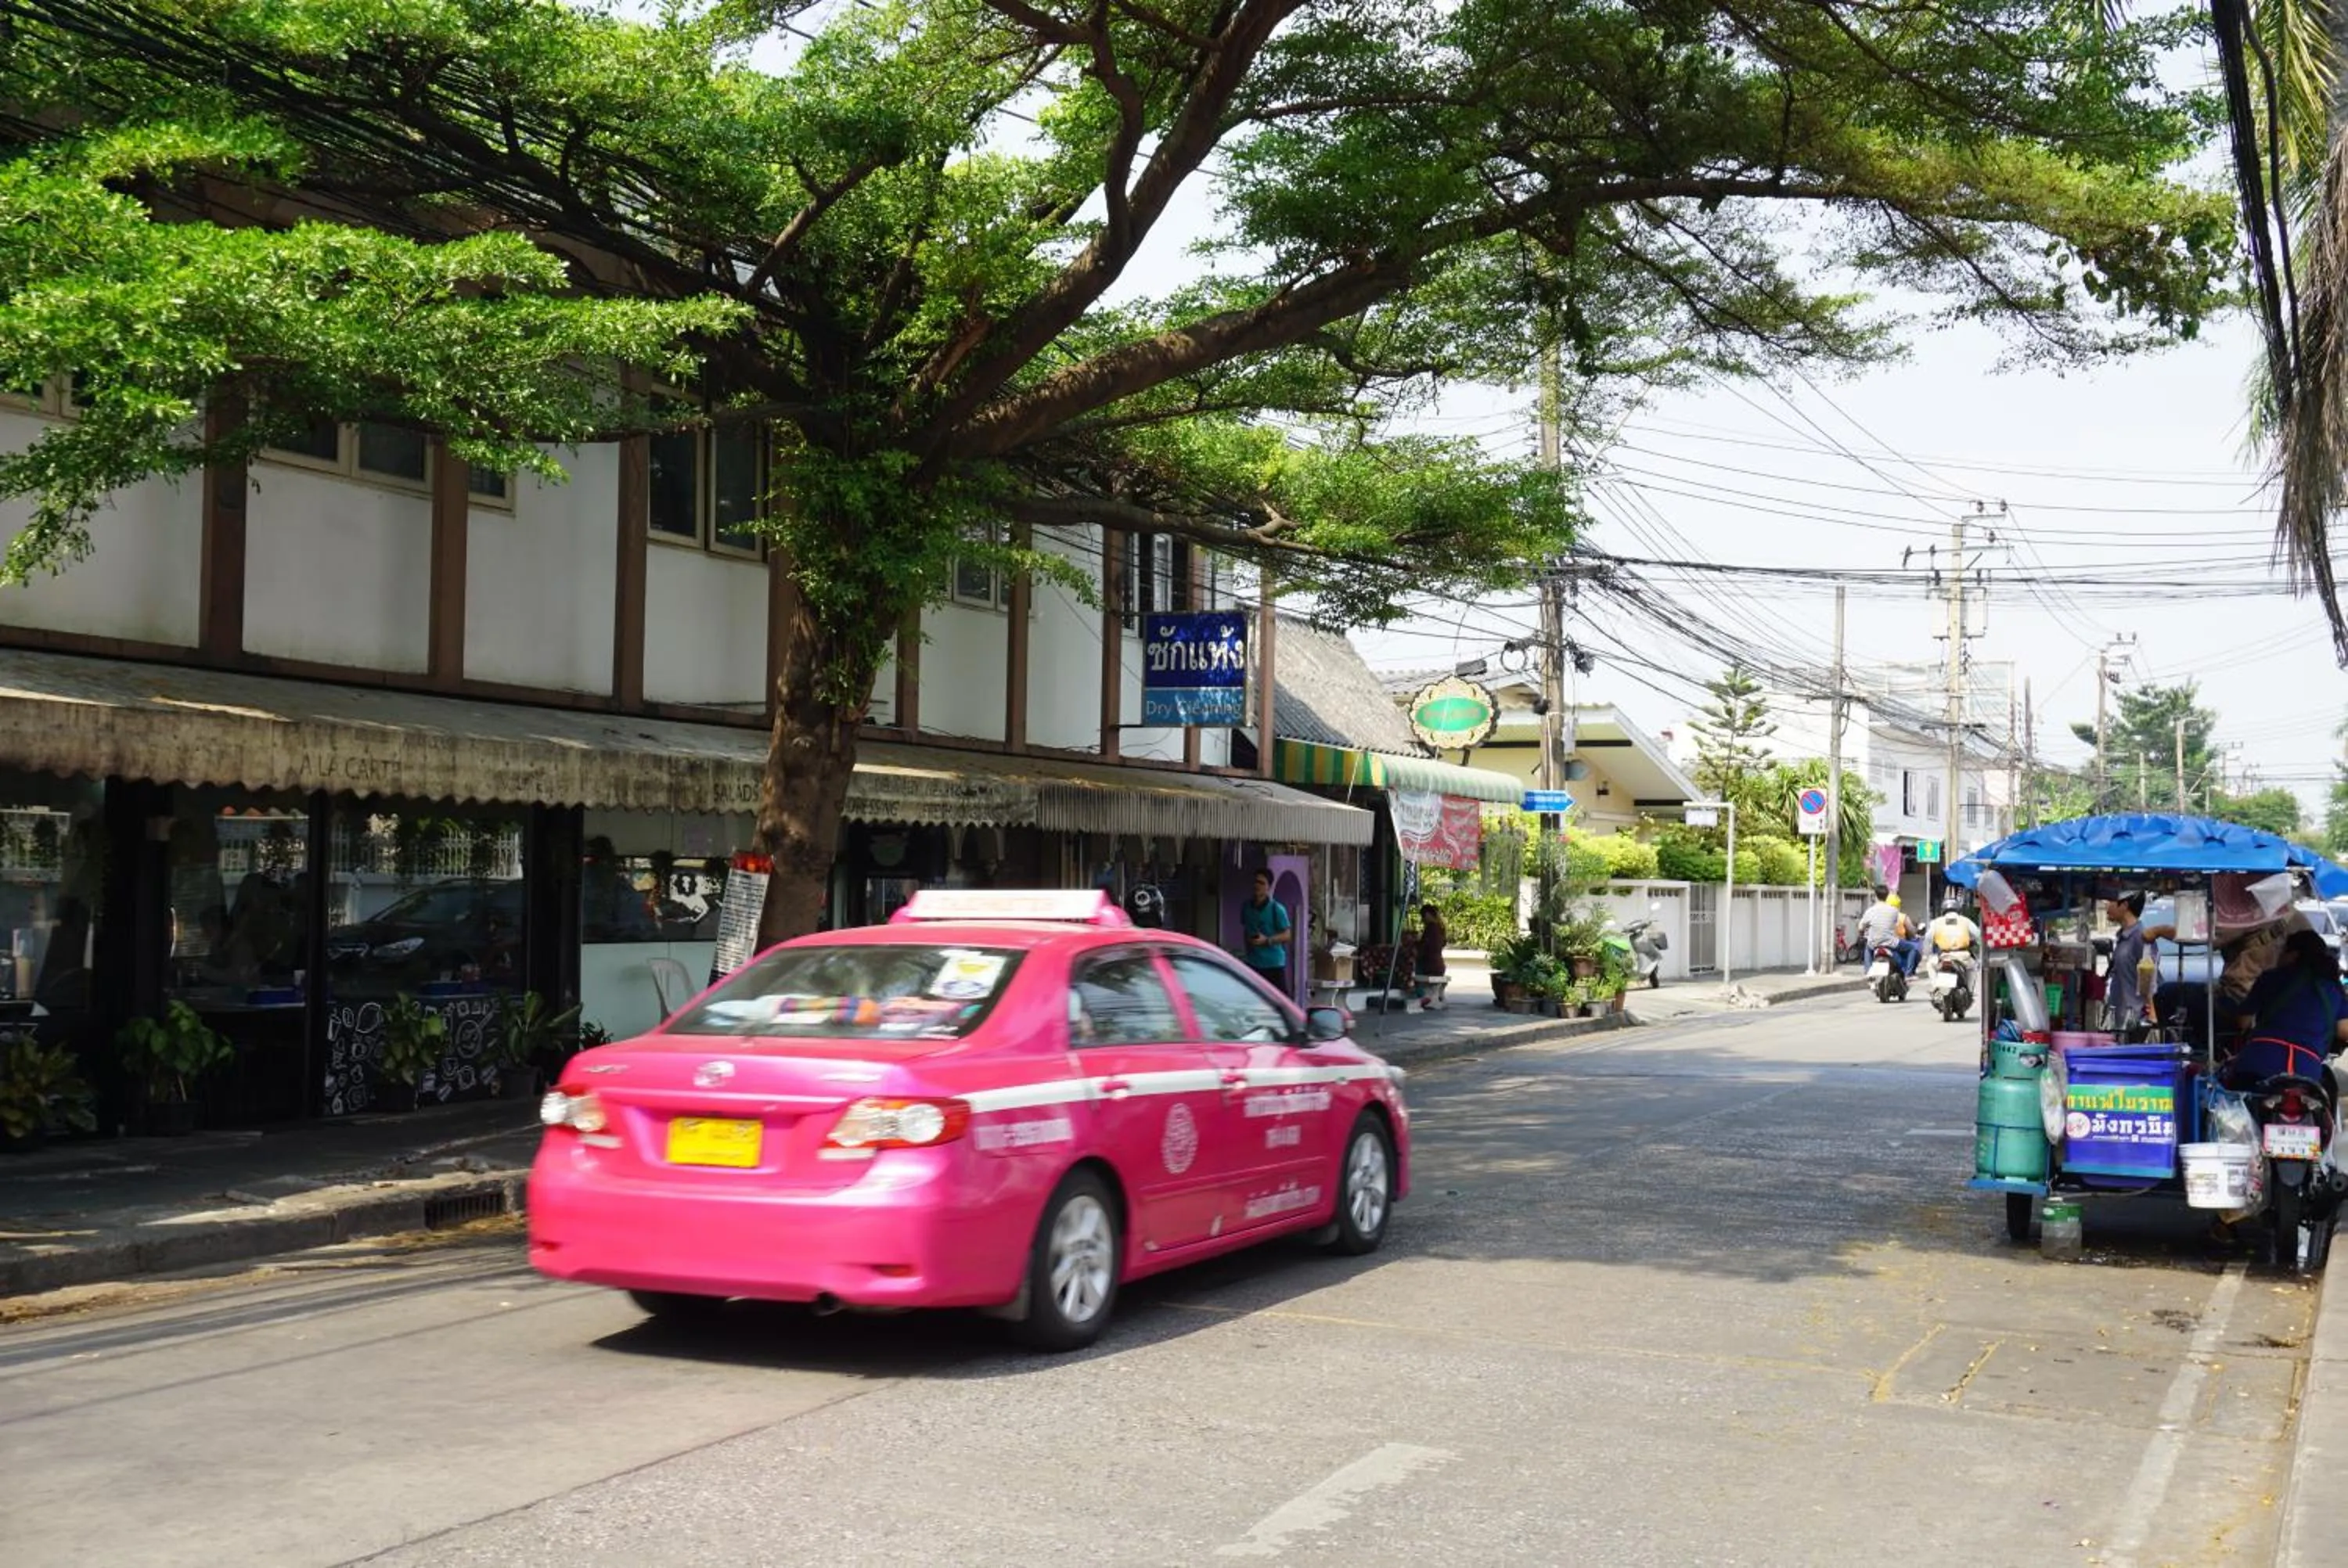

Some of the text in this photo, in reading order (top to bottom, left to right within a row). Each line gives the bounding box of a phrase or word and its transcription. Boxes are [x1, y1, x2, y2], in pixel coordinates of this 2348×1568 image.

[1147, 624, 1244, 671] ซักแห้ง
[1147, 700, 1242, 719] Dry Cleaning
[713, 782, 760, 802] SALADS
